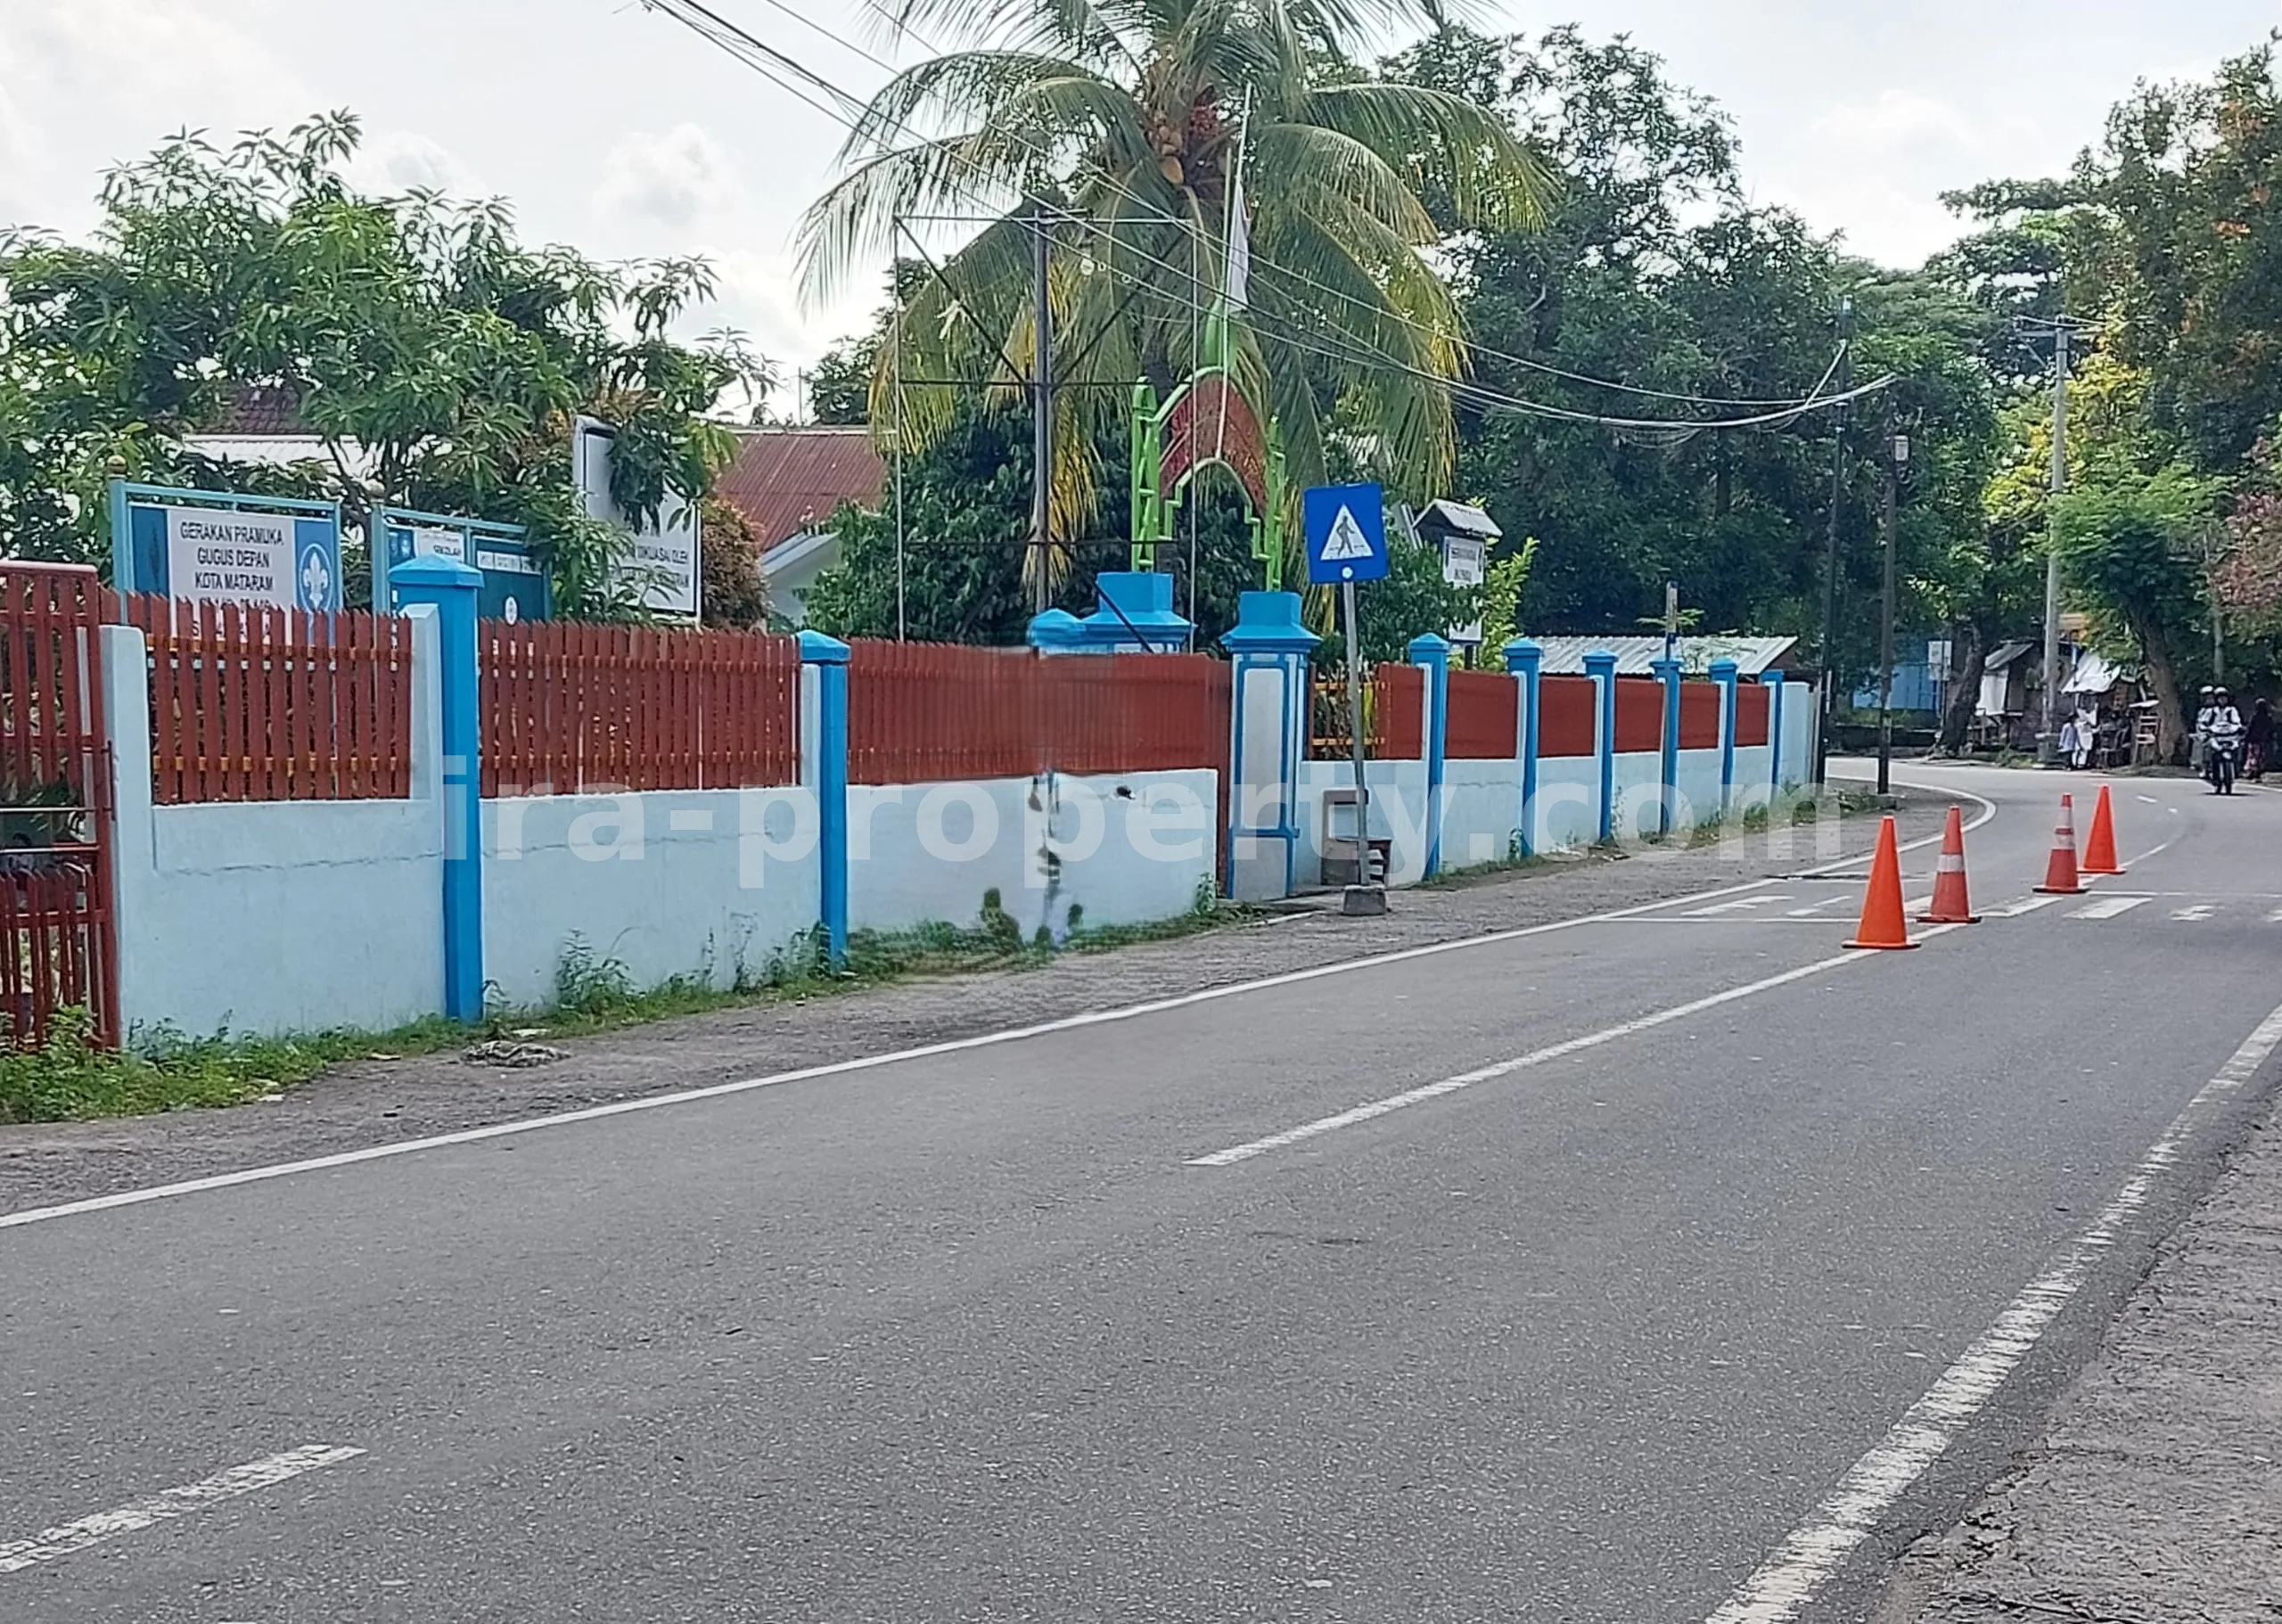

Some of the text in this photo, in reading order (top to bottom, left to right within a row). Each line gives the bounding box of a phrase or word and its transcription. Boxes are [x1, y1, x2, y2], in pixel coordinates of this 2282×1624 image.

[180, 521, 284, 545] GERAKAN PRAMUKA
[197, 546, 270, 568] GUGUS DEPAN
[194, 571, 275, 592] KOTA MATARAM
